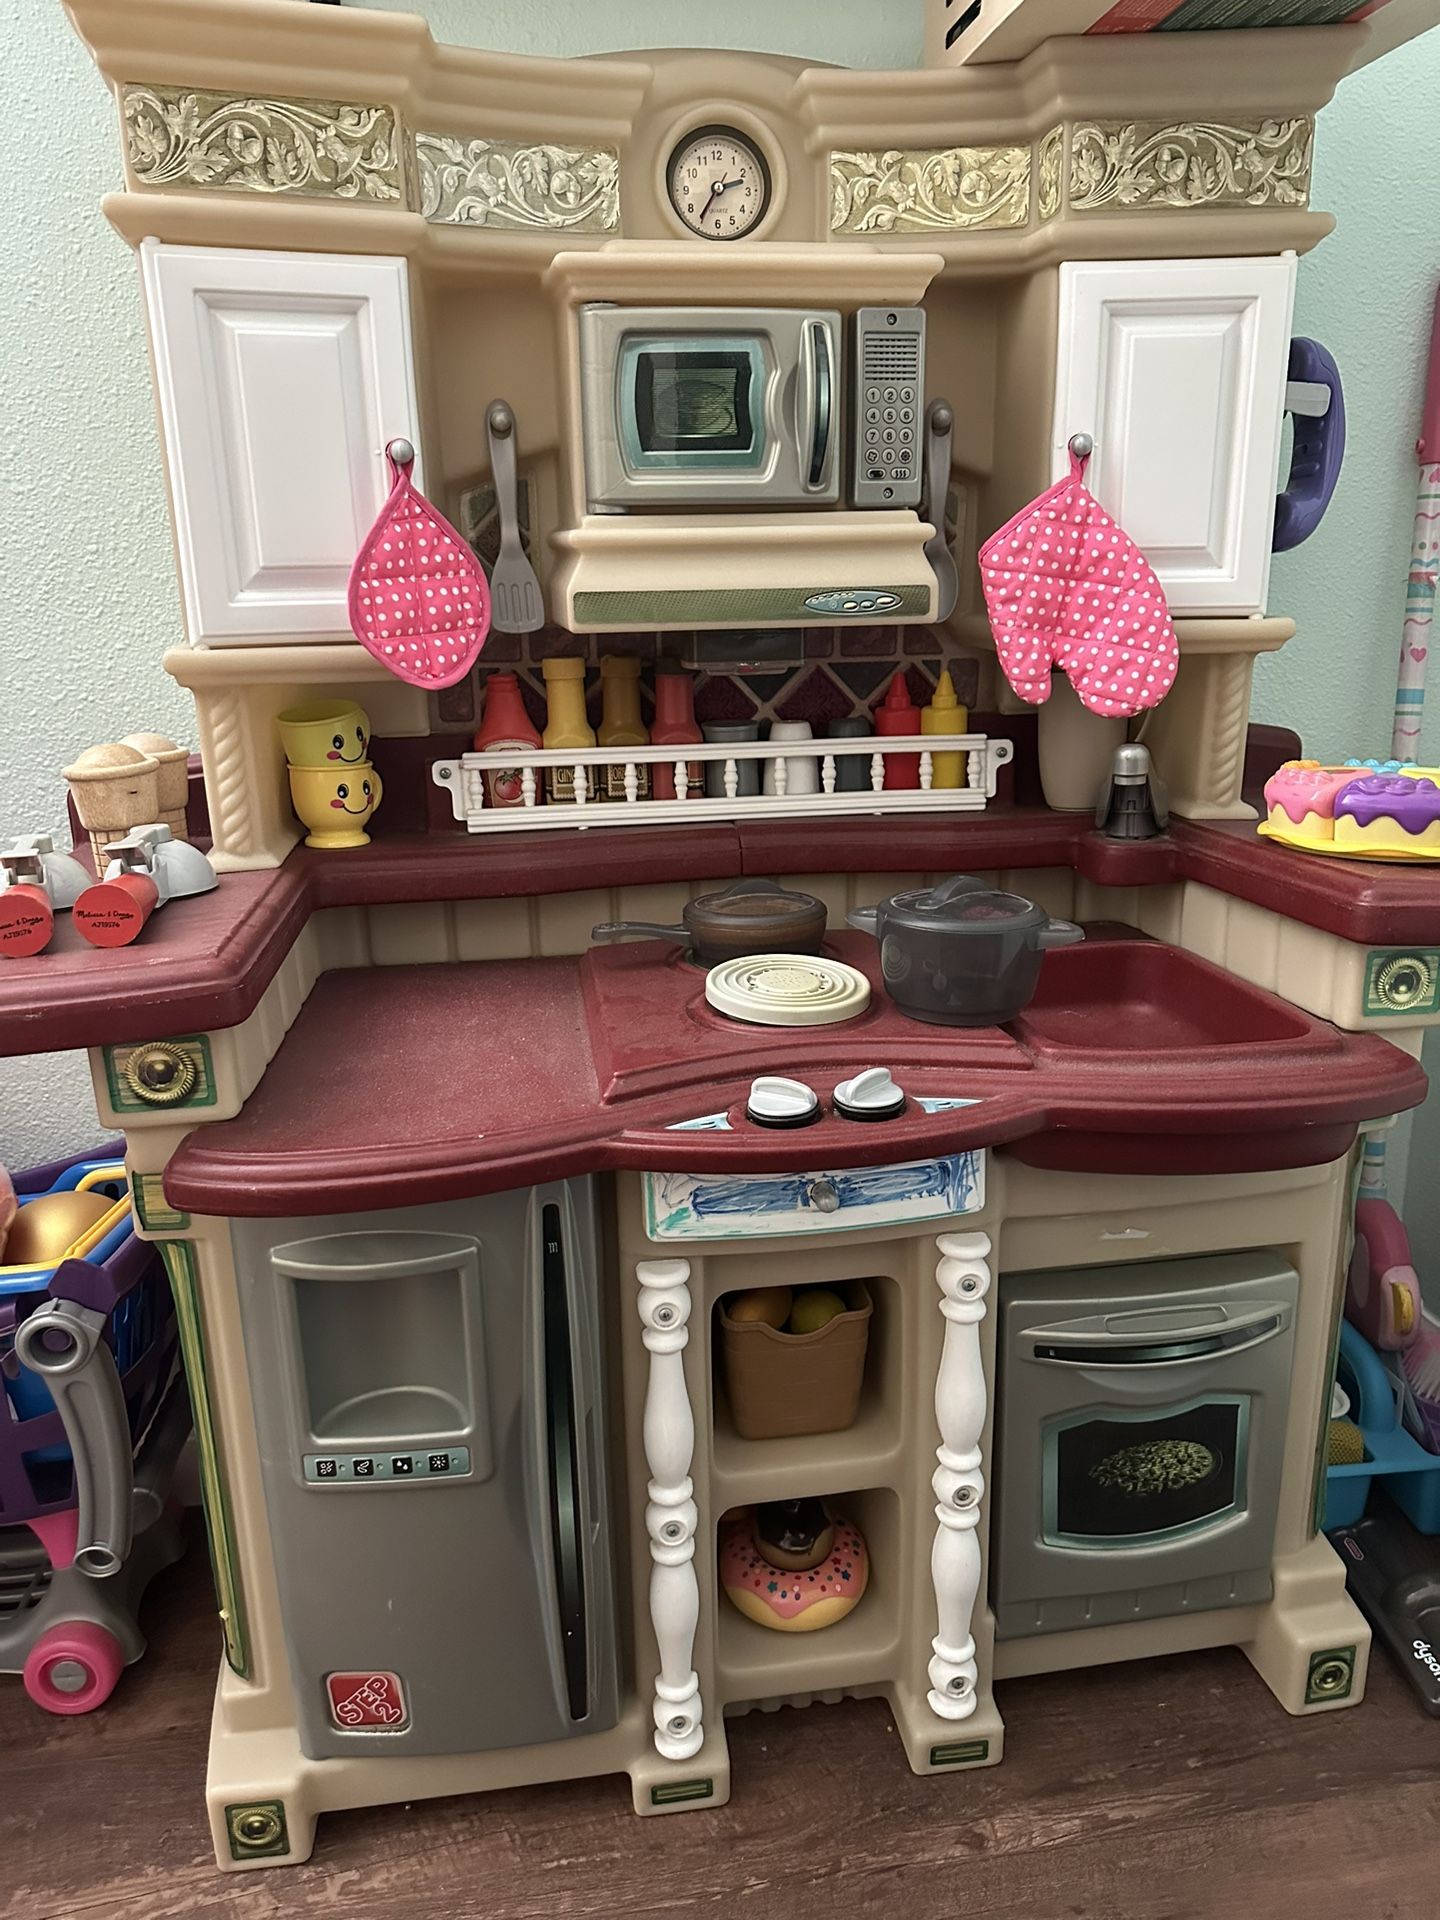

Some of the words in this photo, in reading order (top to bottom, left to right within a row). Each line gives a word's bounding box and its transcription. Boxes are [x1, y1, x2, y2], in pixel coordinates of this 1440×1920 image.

[711, 150, 723, 161] 12
[697, 156, 708, 166] 11
[731, 156, 736, 166] 1
[686, 168, 698, 179] 10
[739, 168, 746, 178] 2
[683, 185, 690, 195] 9
[745, 187, 752, 197] 3
[687, 203, 694, 213] 8
[739, 204, 746, 214] 4
[714, 218, 722, 229] 6
[729, 215, 736, 226] 5
[887, 391, 894, 400] 2
[904, 391, 911, 400] 3
[870, 412, 876, 420] 4
[887, 412, 893, 420] 5
[904, 411, 910, 420] 6
[870, 432, 876, 441] 7
[886, 432, 893, 440] 8
[903, 431, 909, 440] 9
[886, 452, 892, 461] 0
[336, 1675, 389, 1724] STEP
[373, 1701, 401, 1723] 2
